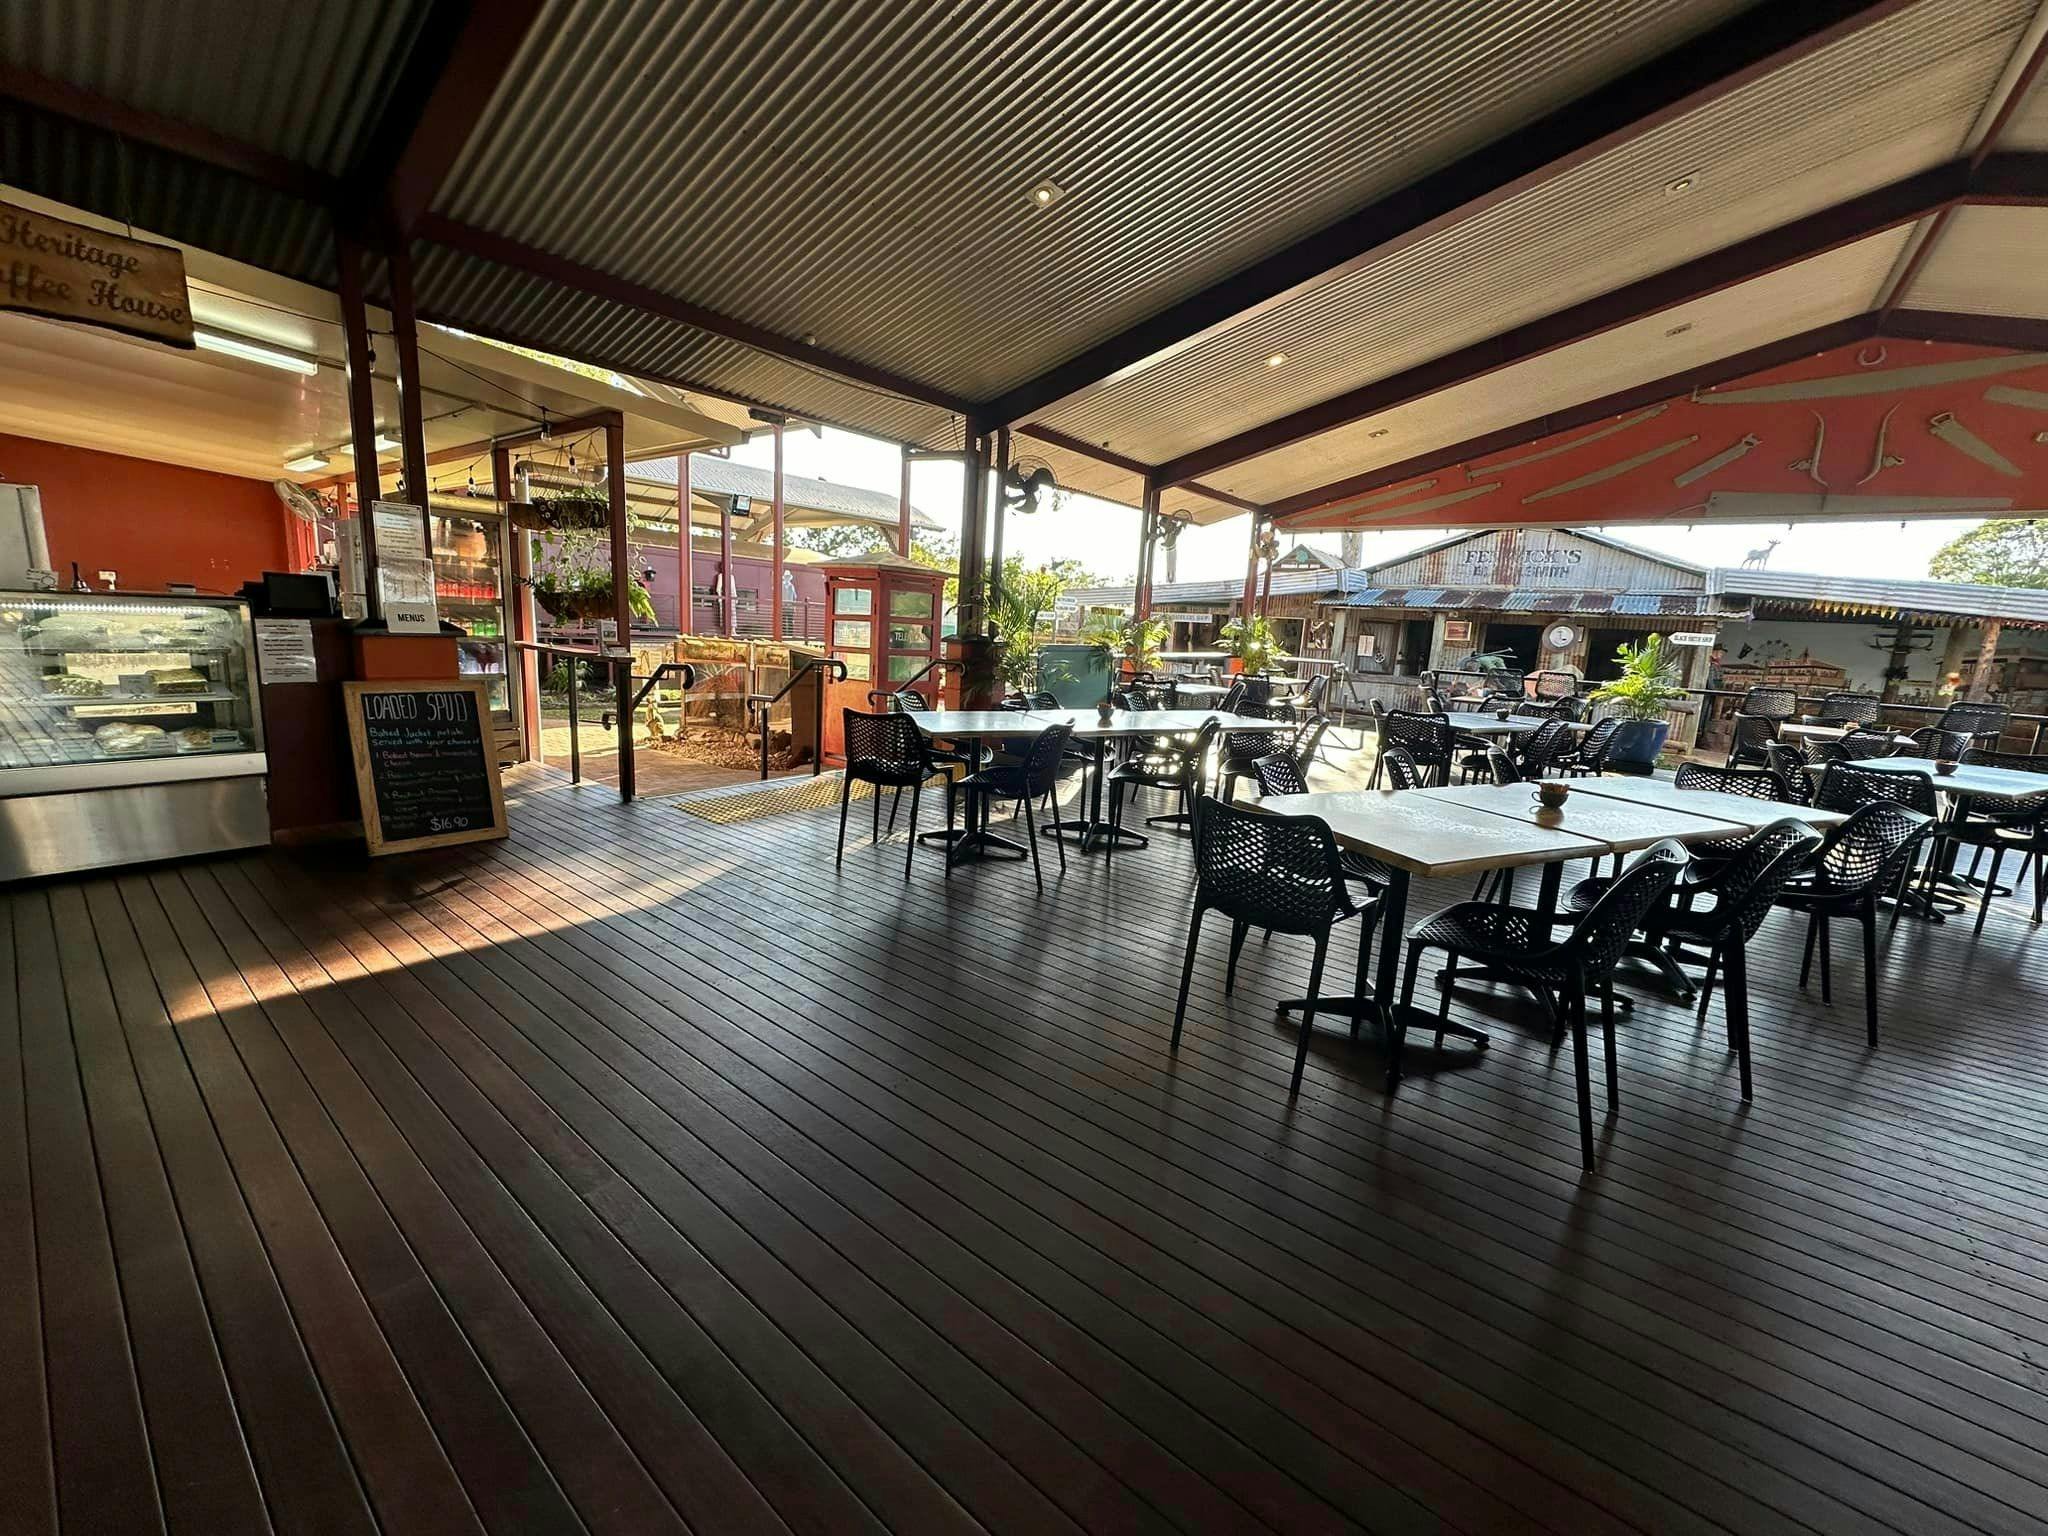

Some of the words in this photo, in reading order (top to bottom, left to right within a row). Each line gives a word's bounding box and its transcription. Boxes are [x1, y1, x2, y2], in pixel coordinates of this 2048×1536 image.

[0, 214, 139, 279] Heritage
[87, 279, 185, 324] House
[397, 613, 426, 622] MENUS
[365, 694, 418, 720] LOADED
[426, 693, 468, 721] SPUD
[430, 816, 469, 831] $16.90
